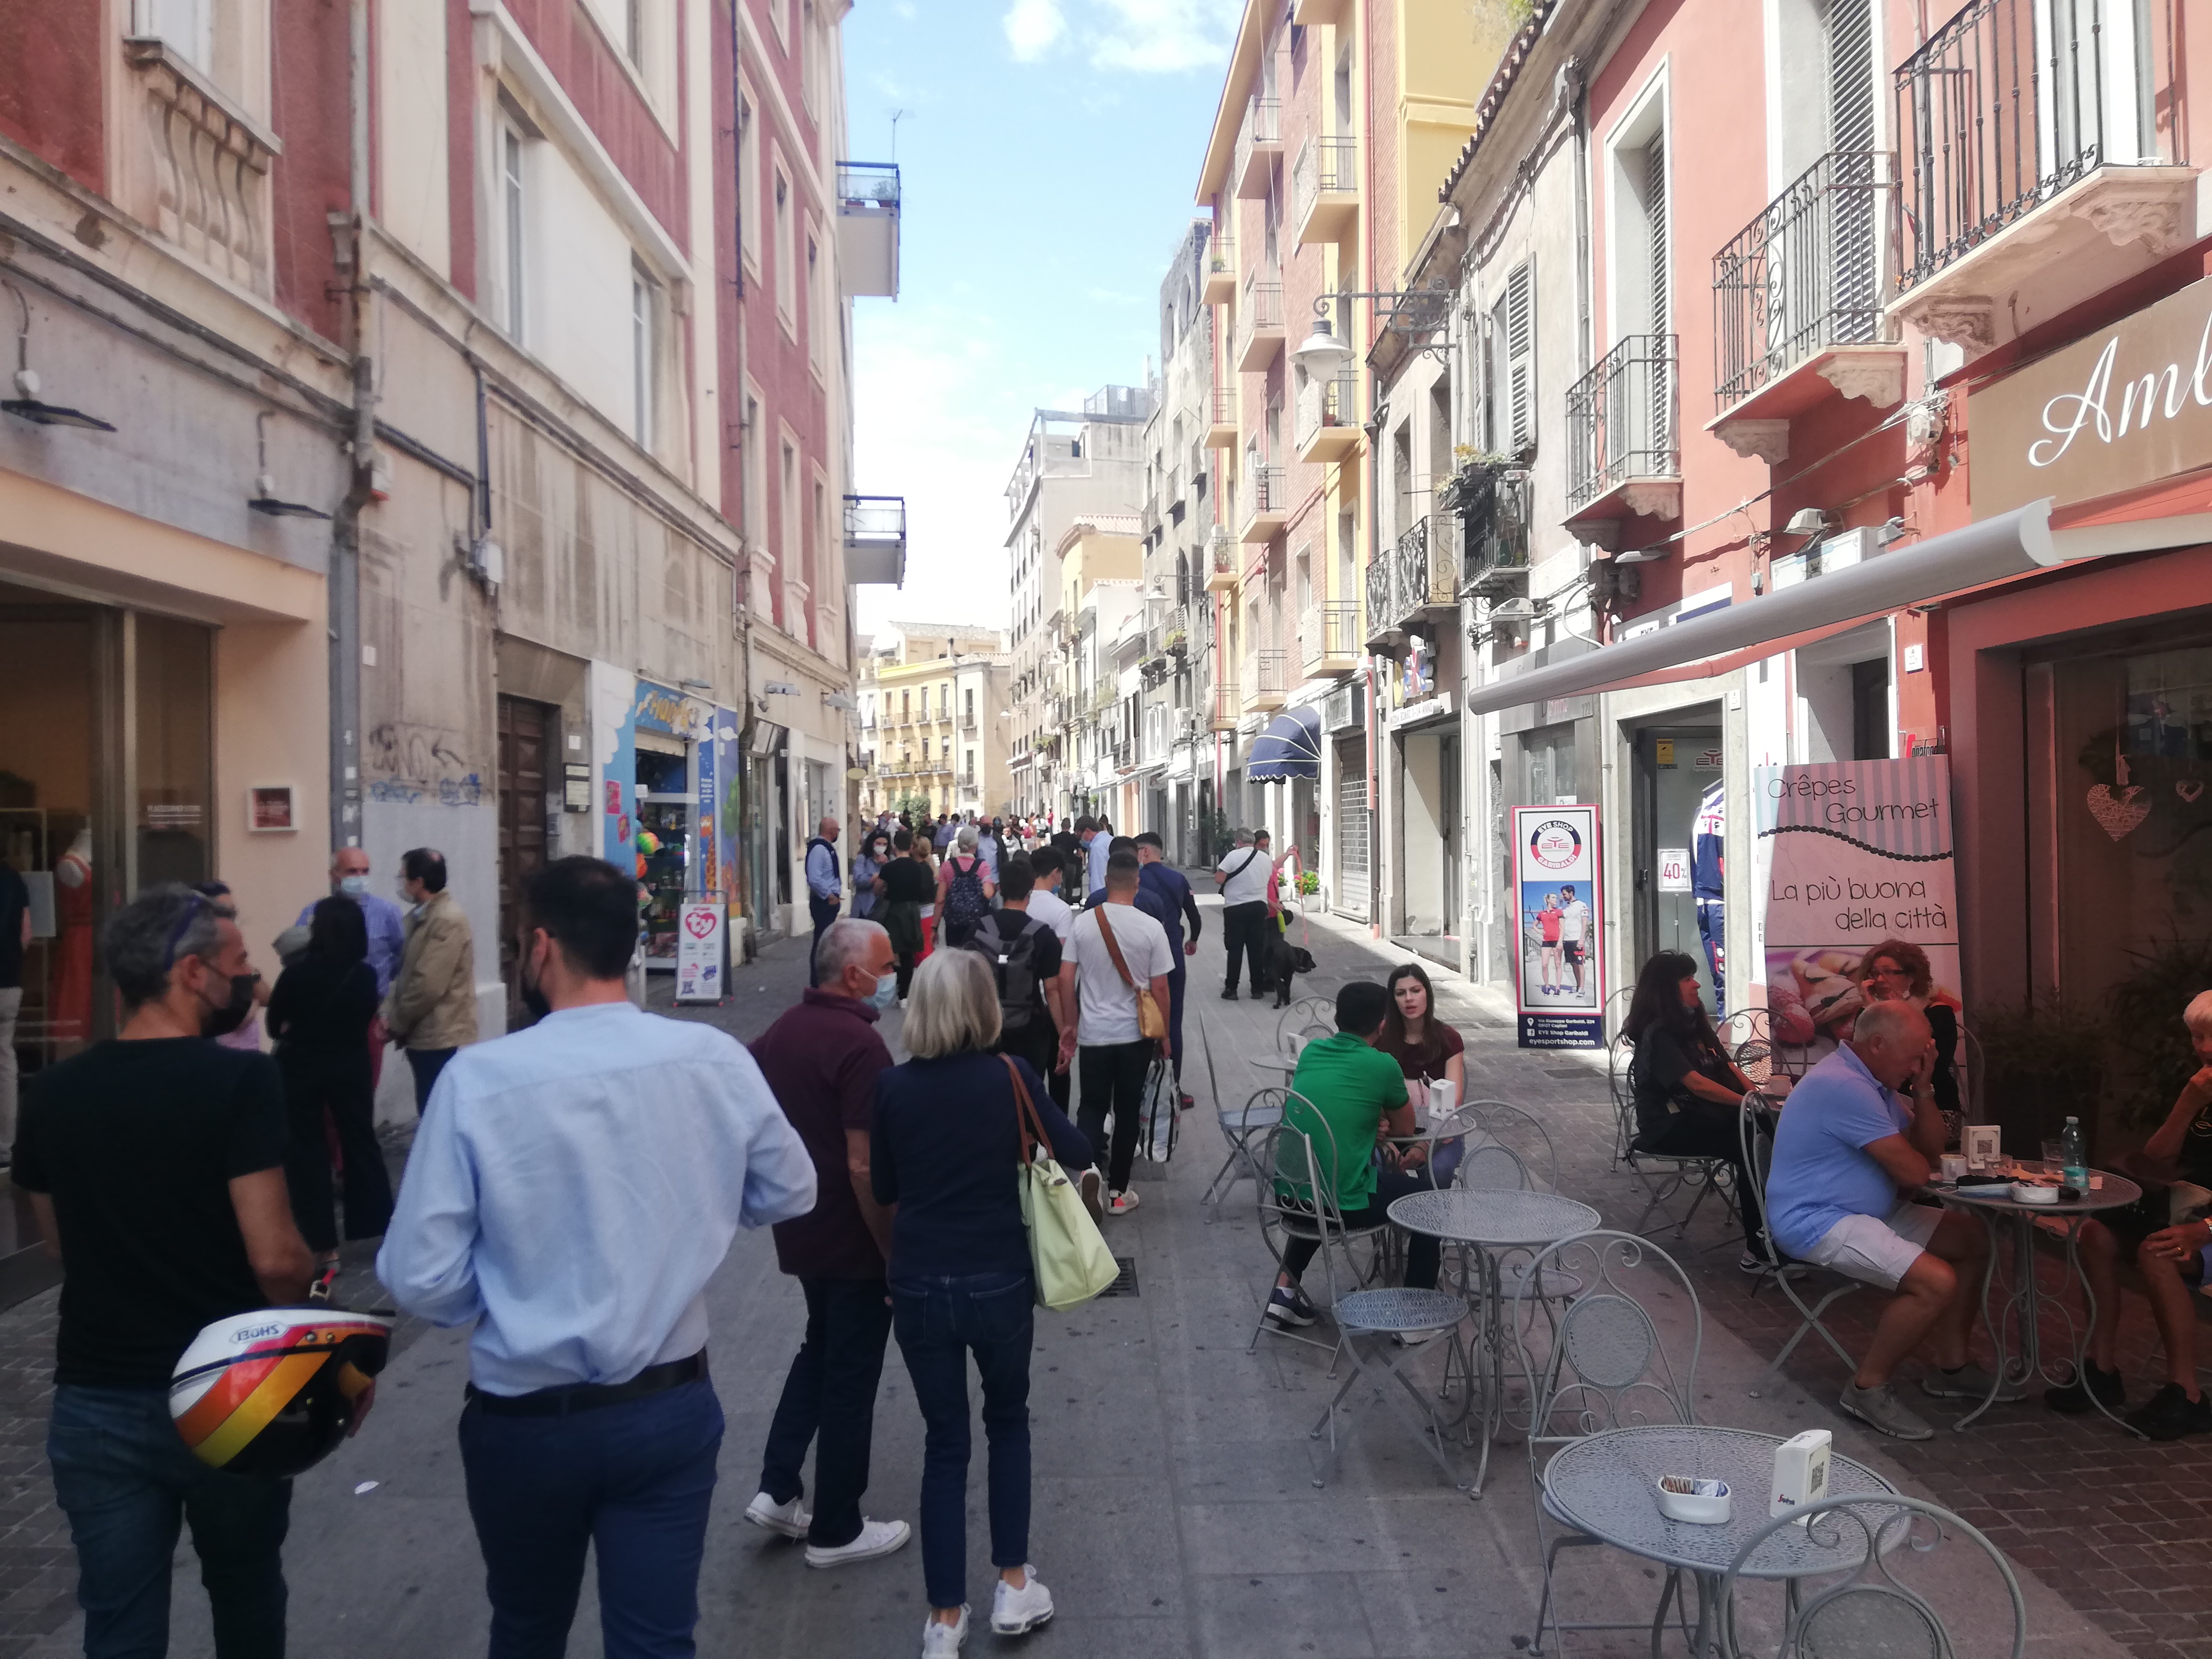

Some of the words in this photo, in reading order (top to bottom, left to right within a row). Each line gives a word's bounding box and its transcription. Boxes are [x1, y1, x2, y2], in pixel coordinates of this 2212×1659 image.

[1767, 774, 1856, 801] Crêpes
[1826, 798, 1939, 824] Gourmet
[1537, 822, 1552, 833] EYE
[1553, 821, 1574, 832] SHOP
[1537, 854, 1577, 868] GARIBALDI
[1772, 880, 1798, 901] La
[1805, 876, 1841, 906] più
[1848, 878, 1926, 900] buona
[1835, 907, 1887, 932] della
[1895, 903, 1948, 929] città
